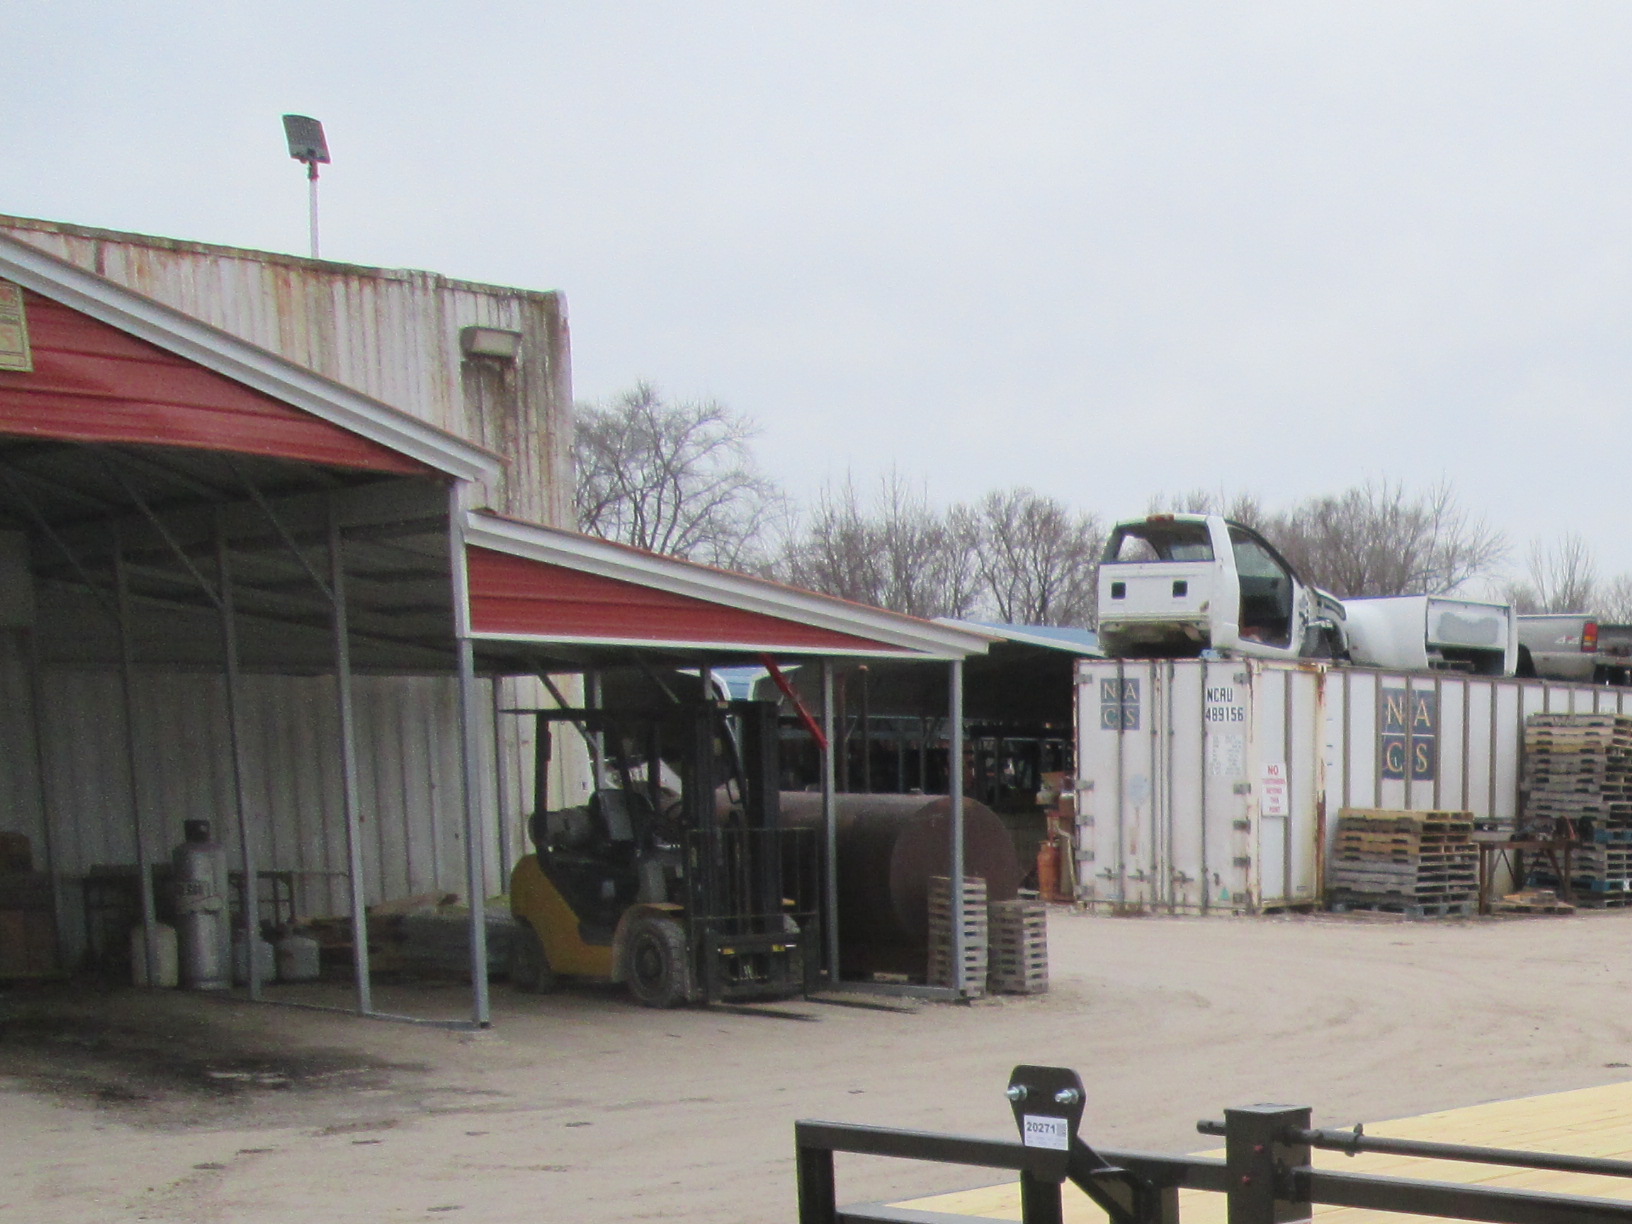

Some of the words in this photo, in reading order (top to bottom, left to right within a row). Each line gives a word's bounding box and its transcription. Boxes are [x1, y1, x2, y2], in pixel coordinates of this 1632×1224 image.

[1205, 706, 1244, 722] 489156
[1267, 764, 1279, 775] NO
[1026, 1121, 1056, 1134] 20271
